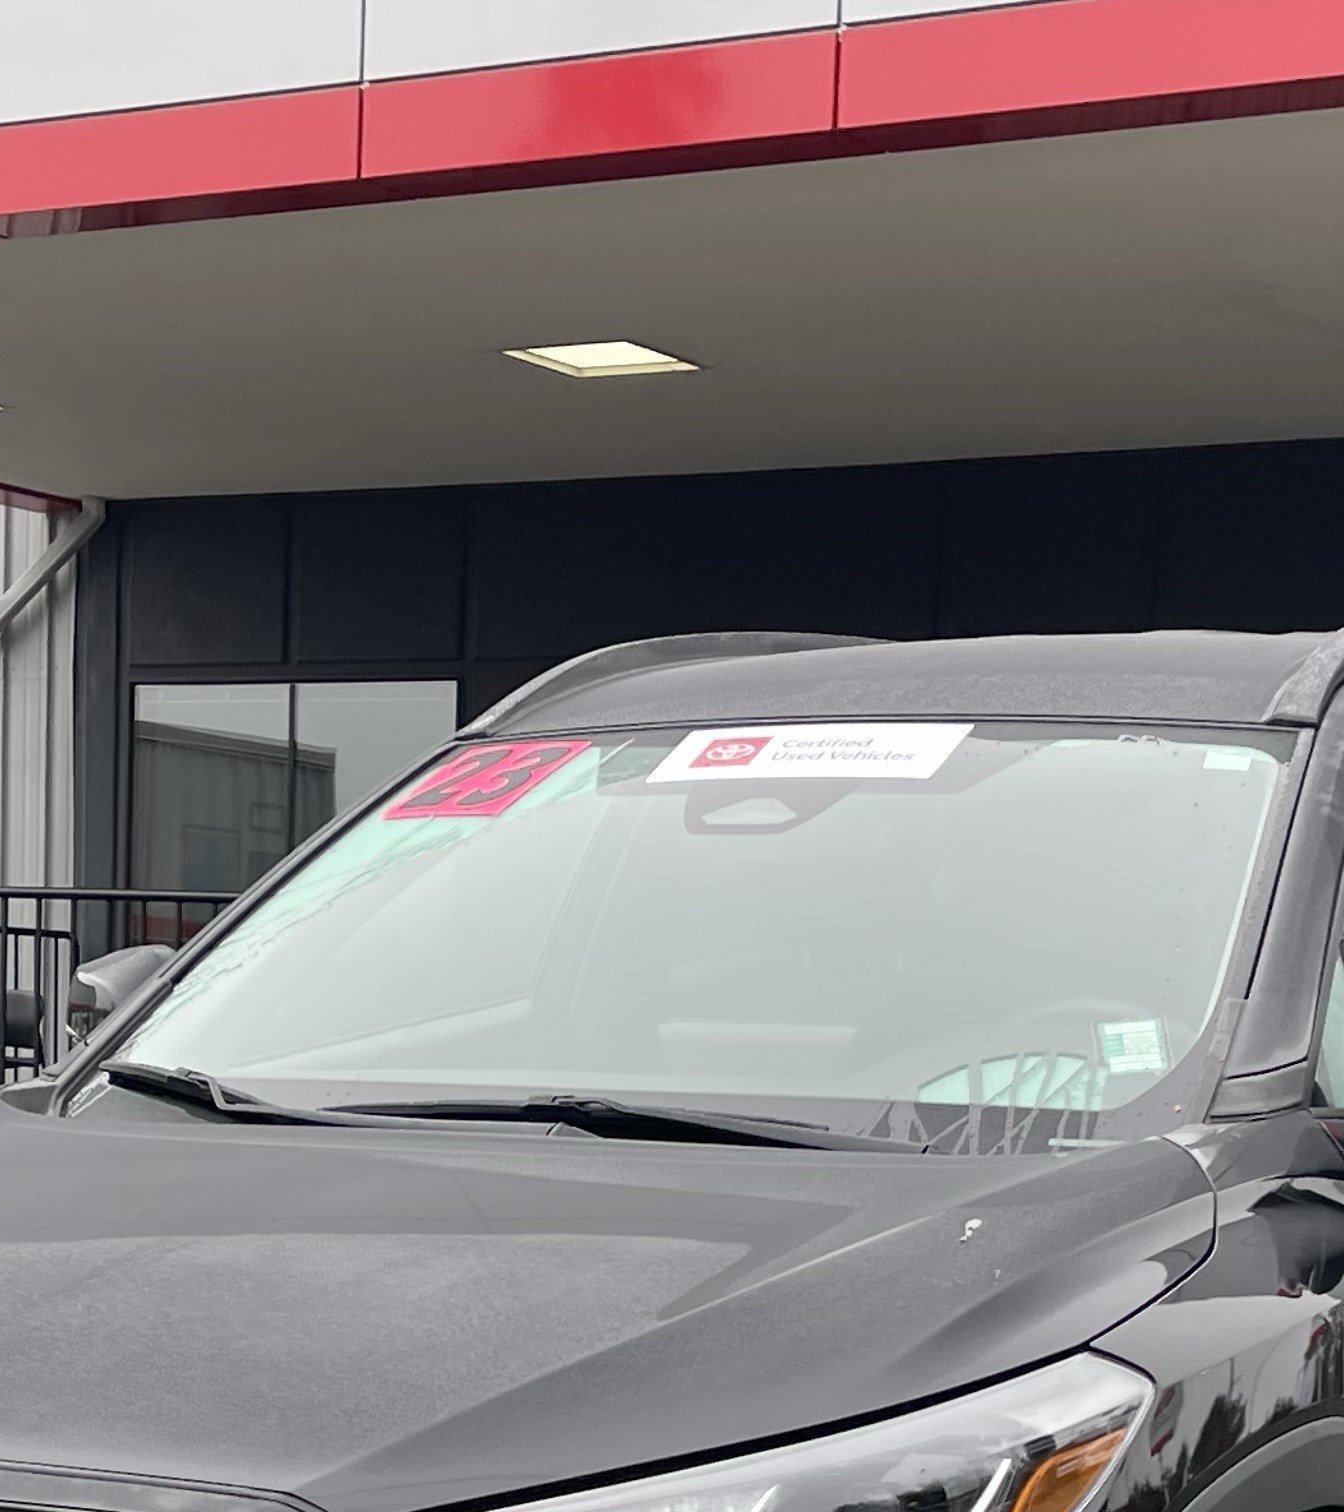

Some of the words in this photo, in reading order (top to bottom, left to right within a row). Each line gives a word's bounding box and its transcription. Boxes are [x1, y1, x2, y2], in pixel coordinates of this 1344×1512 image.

[781, 737, 874, 749] Certified
[771, 750, 824, 762] Used
[830, 750, 915, 762] Vehicles
[399, 747, 572, 810] 23
